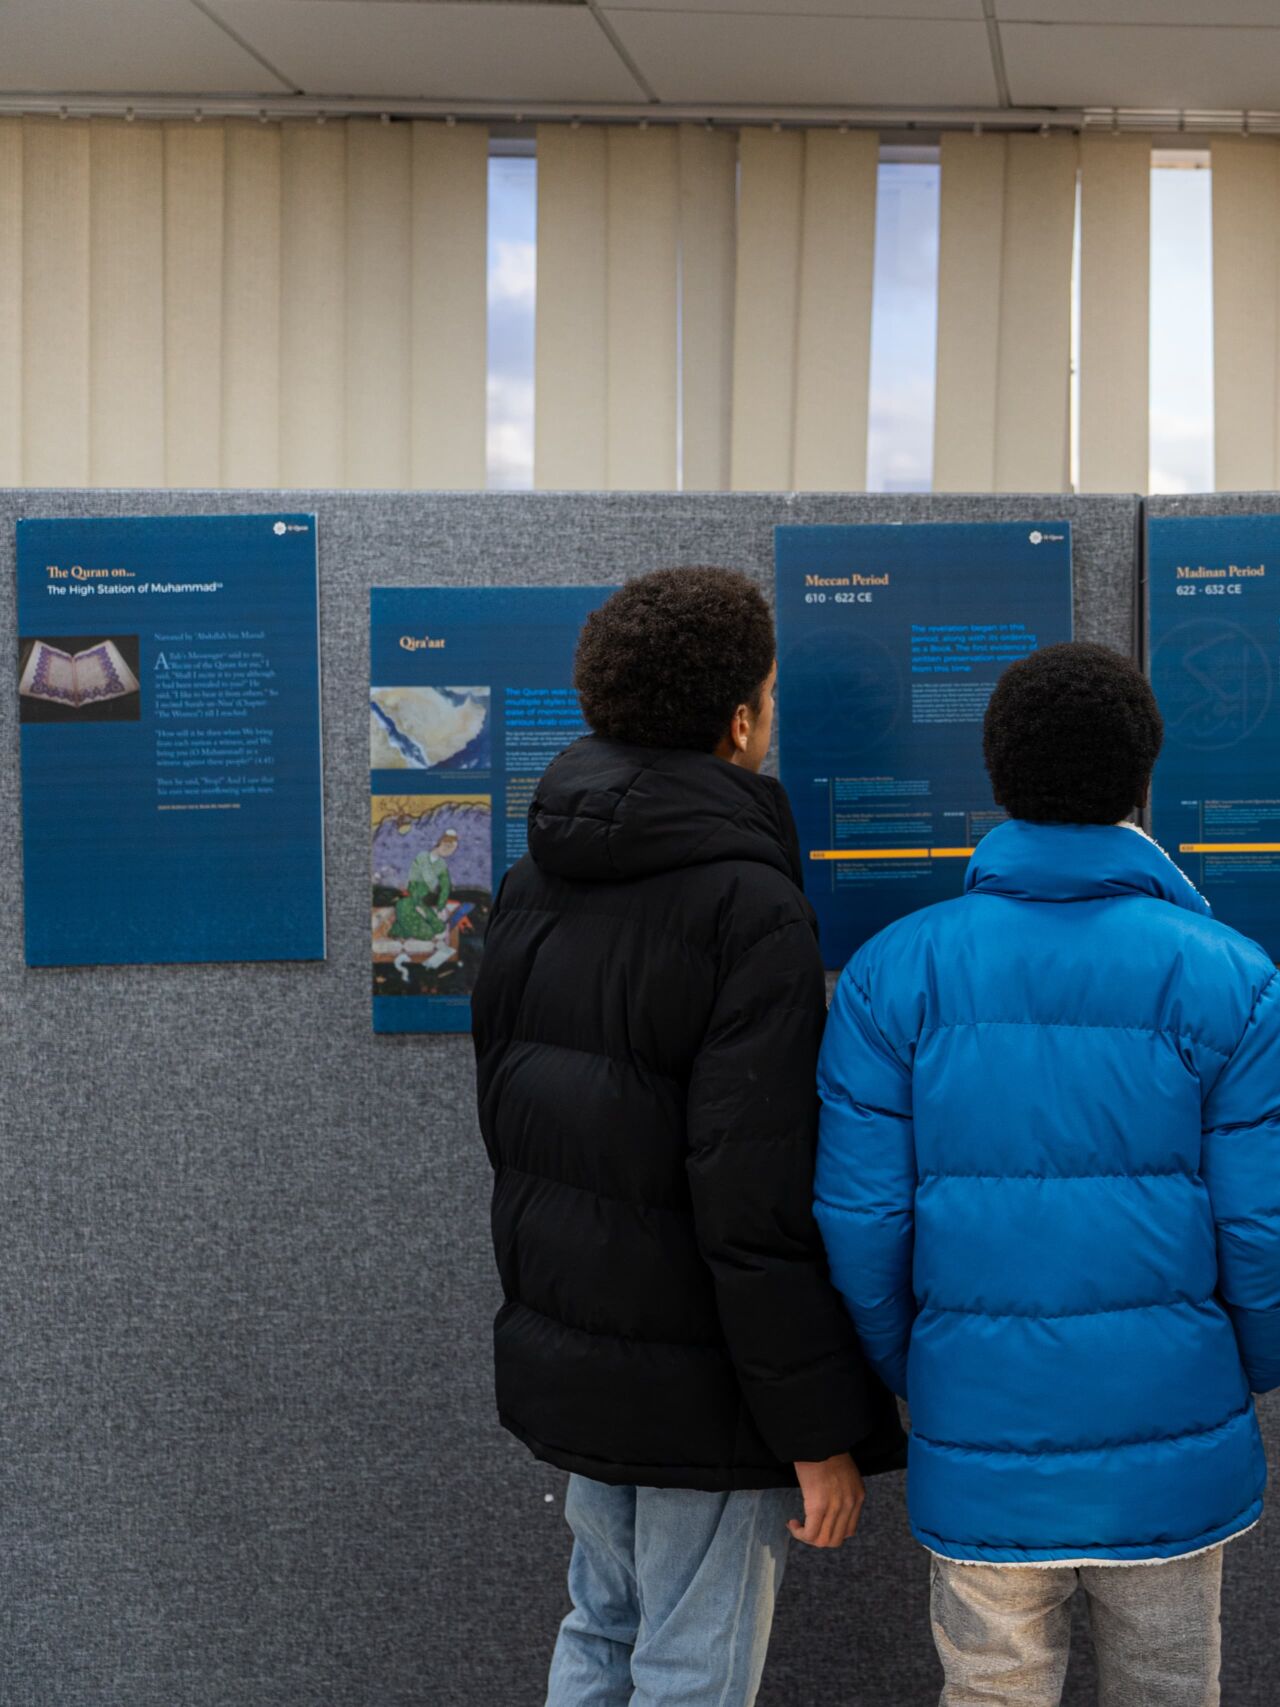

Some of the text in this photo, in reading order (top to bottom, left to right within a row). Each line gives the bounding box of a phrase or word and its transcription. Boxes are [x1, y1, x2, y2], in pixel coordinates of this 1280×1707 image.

[47, 566, 136, 581] The Quran on...
[1176, 564, 1265, 579] Madinan Period
[805, 572, 889, 587] Meccan Period
[47, 584, 66, 595] The
[69, 584, 95, 597] High
[97, 583, 135, 595] Station
[138, 583, 149, 593] of
[1176, 585, 1196, 595] 622
[1204, 584, 1225, 595] 632
[1227, 584, 1242, 594] CE
[805, 592, 826, 603] 610
[834, 592, 855, 603] 622
[857, 592, 872, 602] CE
[399, 635, 446, 652] Qira'aat
